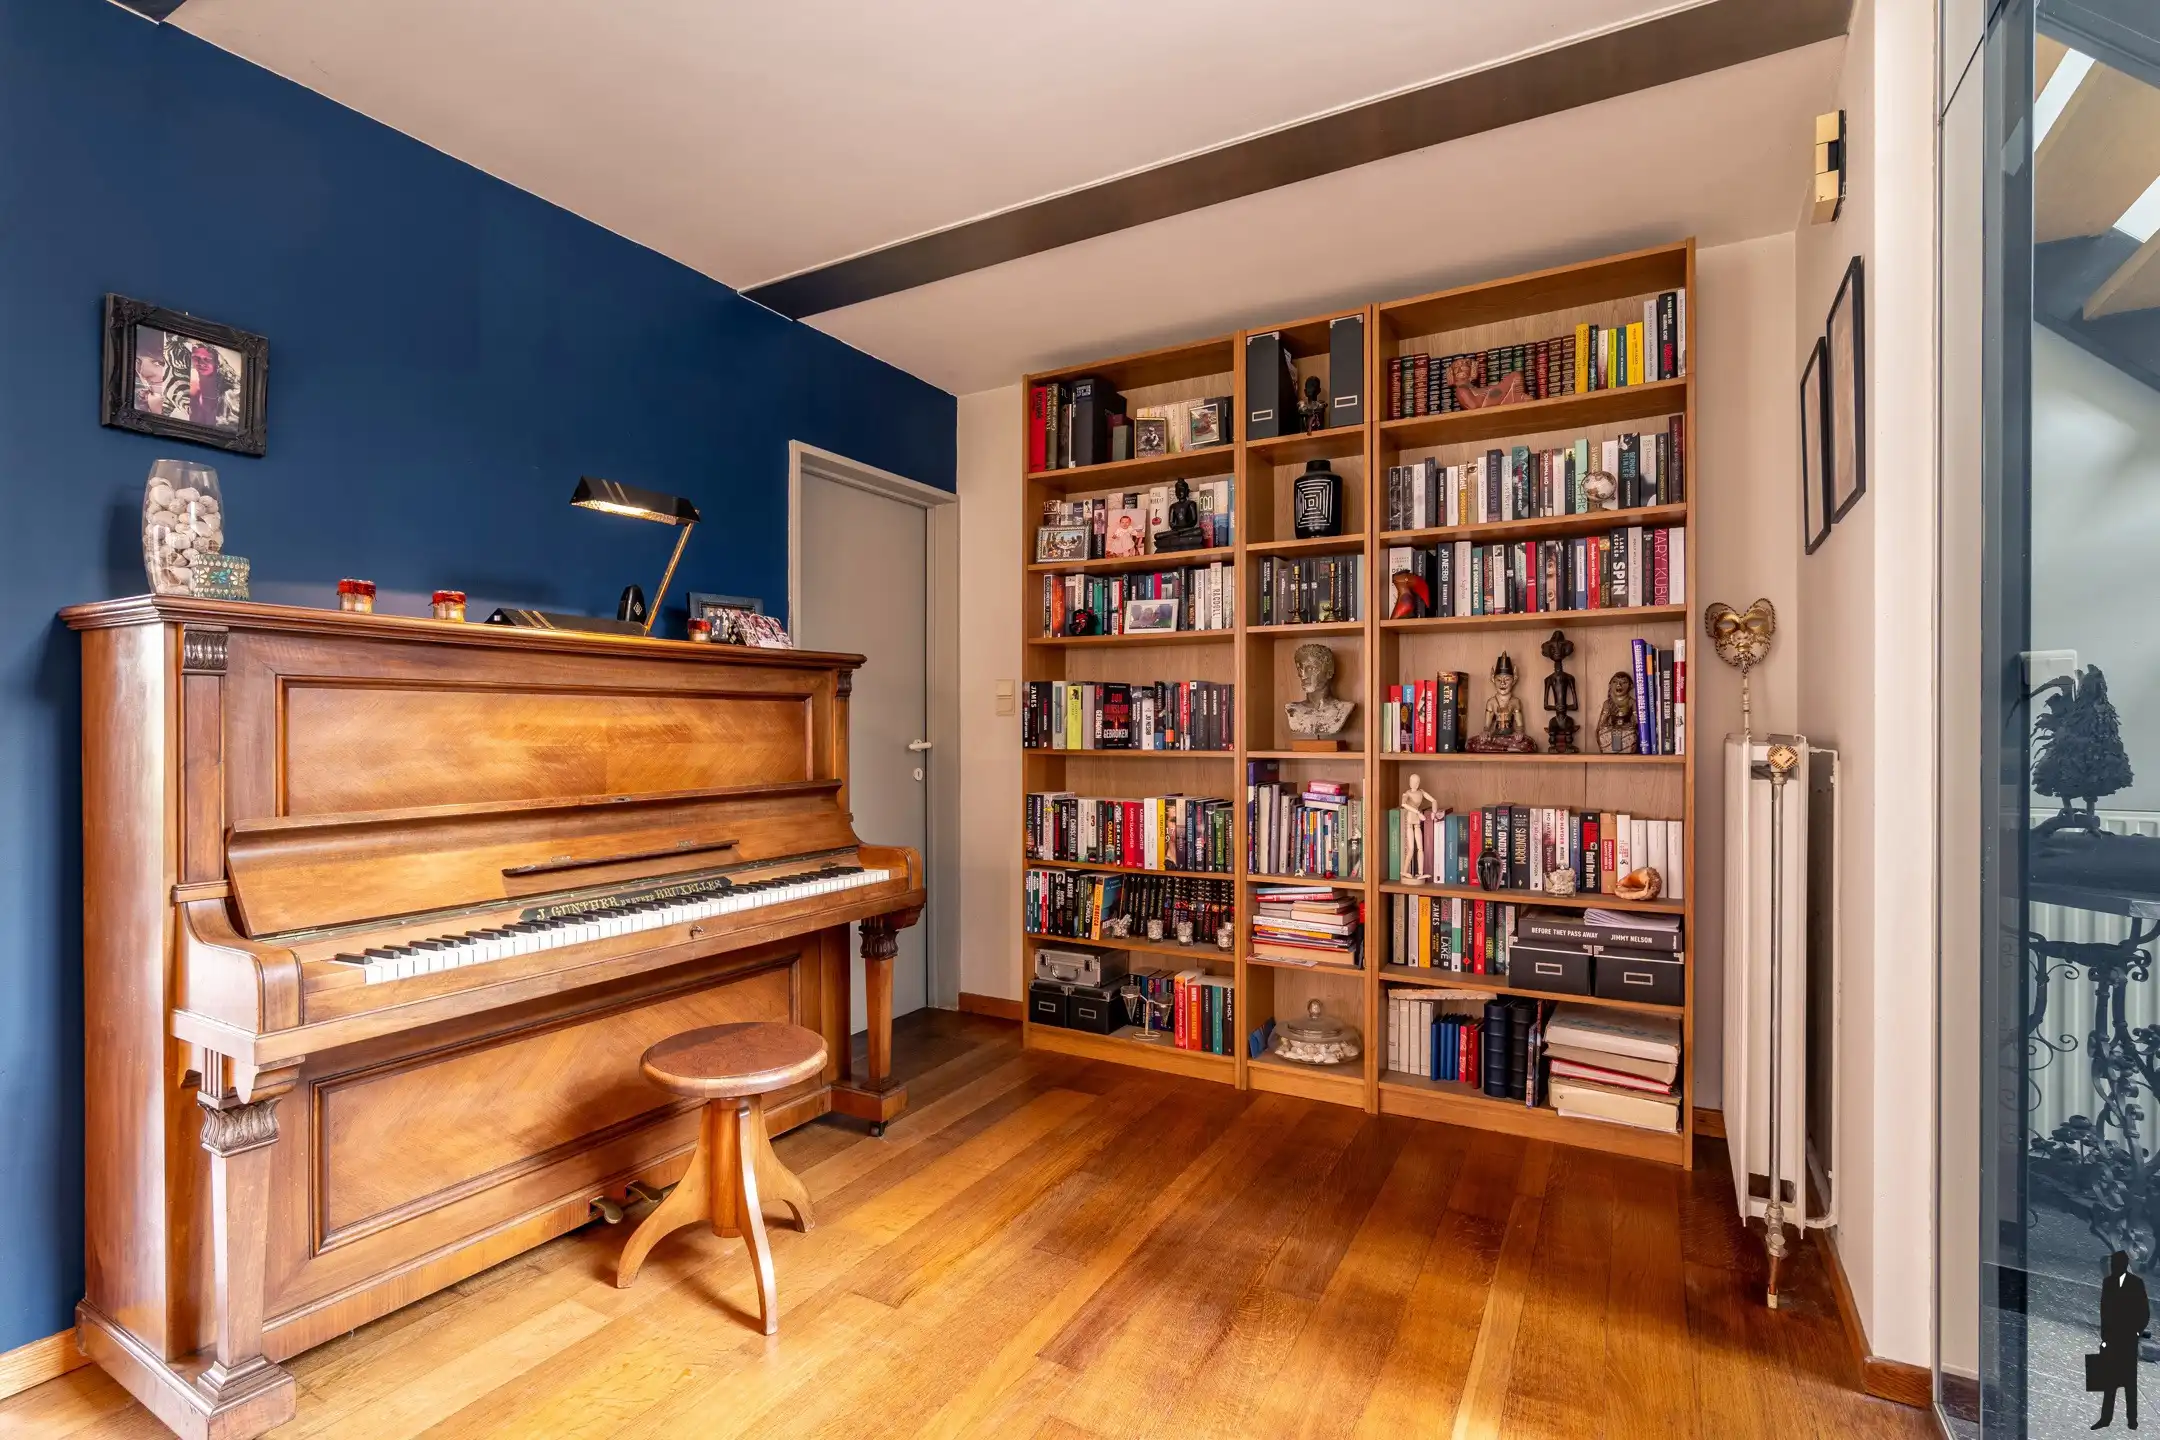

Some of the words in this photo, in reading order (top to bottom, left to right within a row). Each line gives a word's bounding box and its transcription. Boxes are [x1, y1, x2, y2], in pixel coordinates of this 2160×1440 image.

[1442, 549, 1448, 558] JO
[1613, 562, 1626, 595] SPIN
[1499, 832, 1508, 857] ONDER
[1515, 828, 1526, 864] SHANTARAM
[536, 909, 549, 920] J.
[656, 880, 722, 898] BRUXELLES
